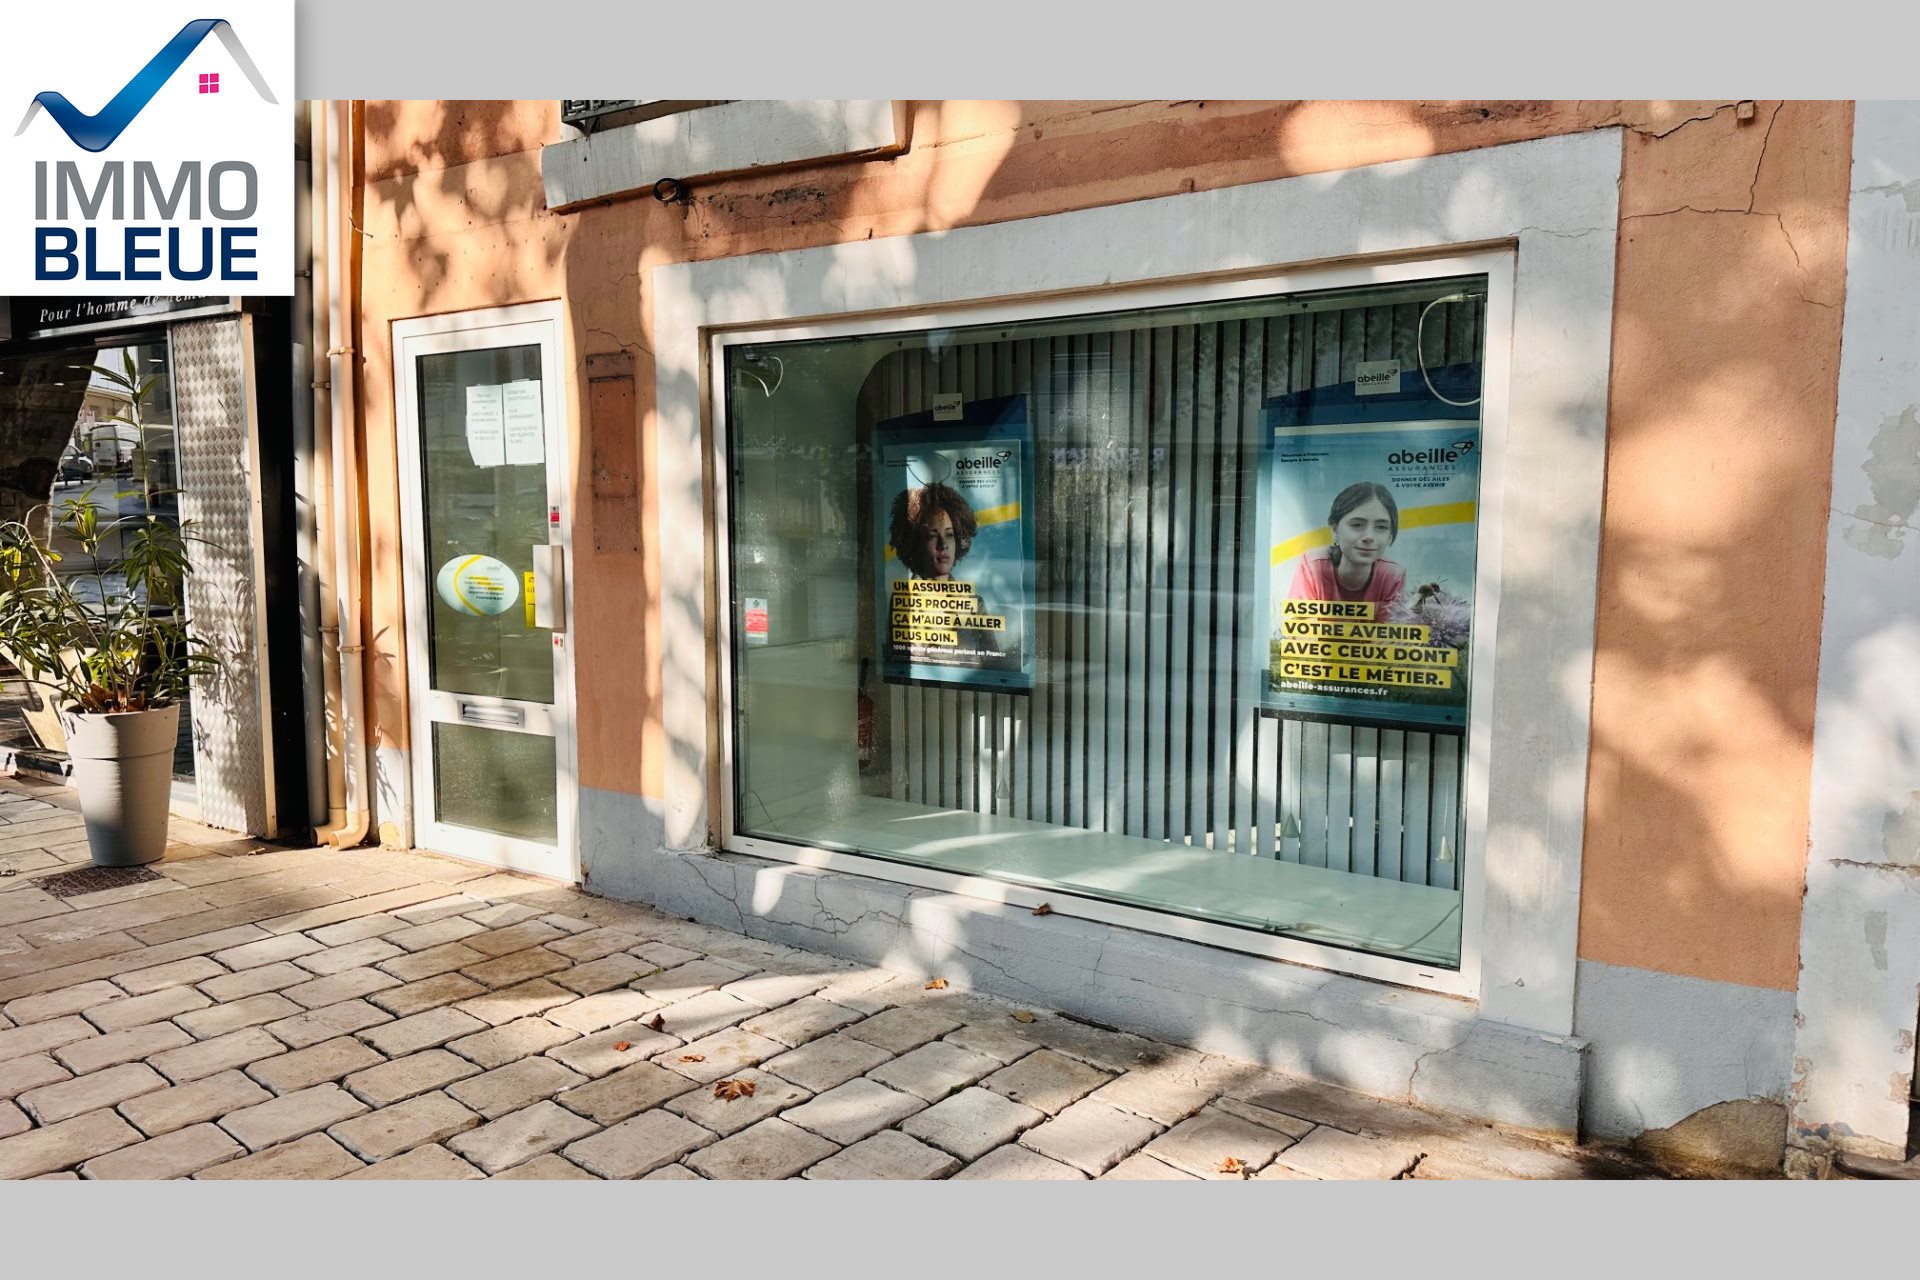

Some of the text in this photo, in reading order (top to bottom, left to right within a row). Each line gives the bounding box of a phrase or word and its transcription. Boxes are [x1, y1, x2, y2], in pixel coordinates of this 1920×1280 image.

[40, 307, 71, 323] Pour
[76, 298, 137, 318] l'homme
[143, 296, 159, 307] de
[1358, 373, 1391, 383] abeille
[956, 456, 1001, 470] abeille
[1388, 448, 1458, 465] abeille
[893, 581, 972, 593] UN ASSUREUR
[894, 597, 976, 615] PLUS PROCHE,
[1284, 602, 1368, 616] ASSUREZ
[894, 613, 1002, 629] ÇA M'AIDE À ALLER
[894, 631, 954, 643] PLUS LOIN.
[1284, 622, 1422, 641] VOTRE AVENIR
[985, 650, 1007, 658] France
[1284, 642, 1450, 664] AVEC CEUX DONT
[1283, 663, 1445, 686] C'EST LE MÉTIER.
[1280, 680, 1388, 696] abeille-assurances.fr
